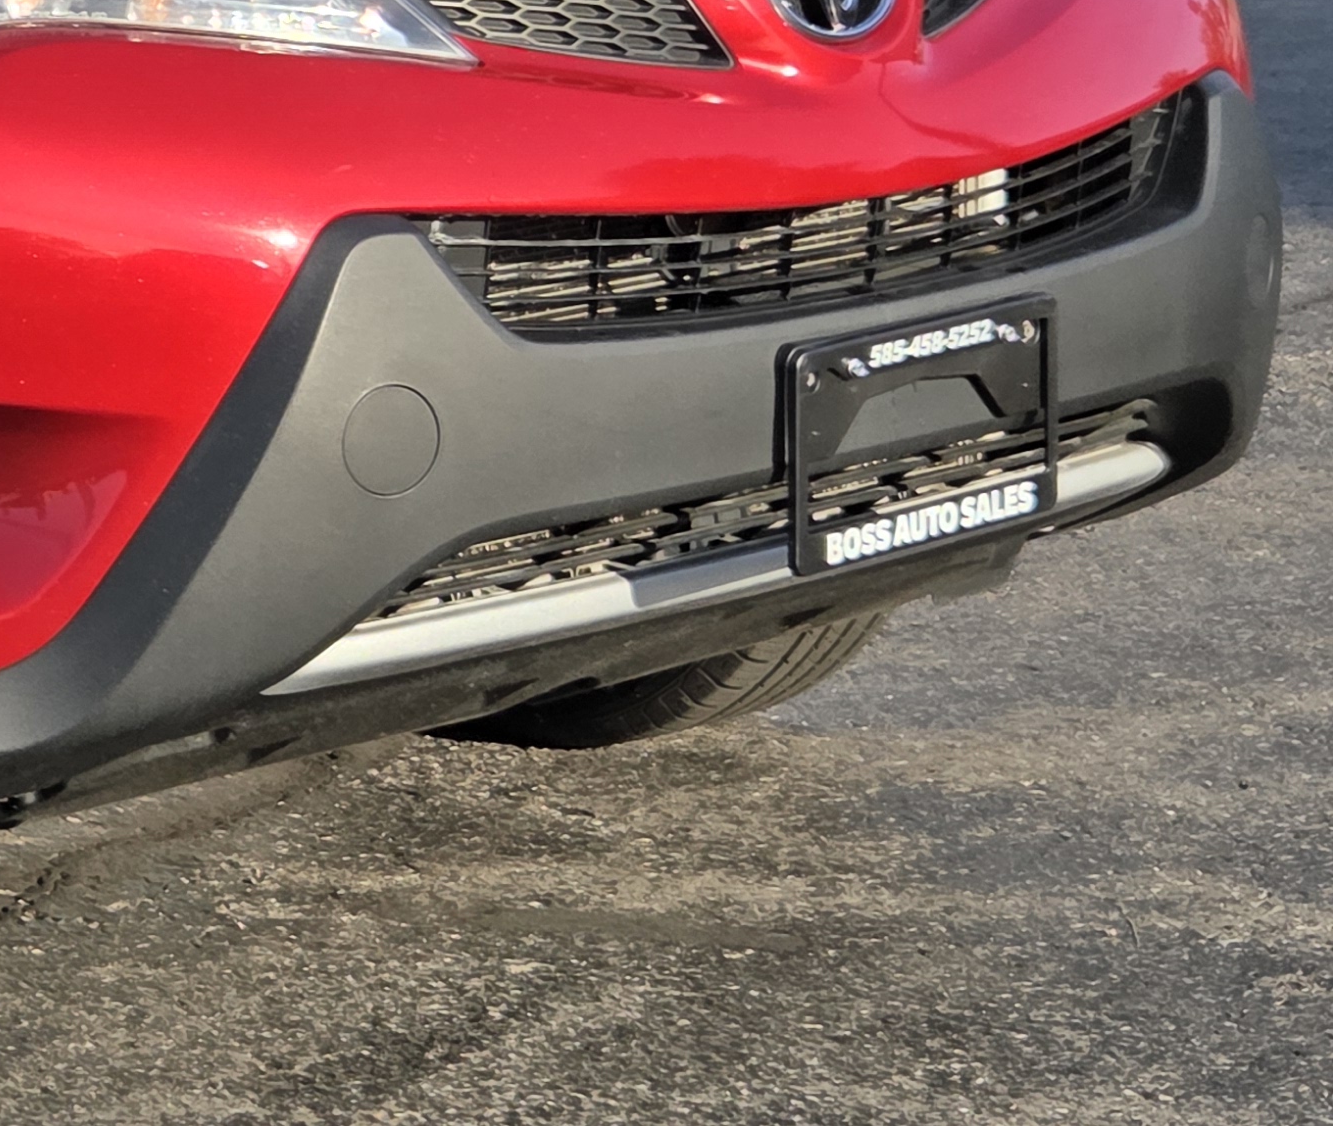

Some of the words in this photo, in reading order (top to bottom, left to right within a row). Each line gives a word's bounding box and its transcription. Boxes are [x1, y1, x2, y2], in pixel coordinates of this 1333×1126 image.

[868, 318, 996, 369] 585-458-5252
[826, 519, 895, 566] BOSS
[893, 501, 960, 547] AUTO
[959, 480, 1039, 529] SALES
